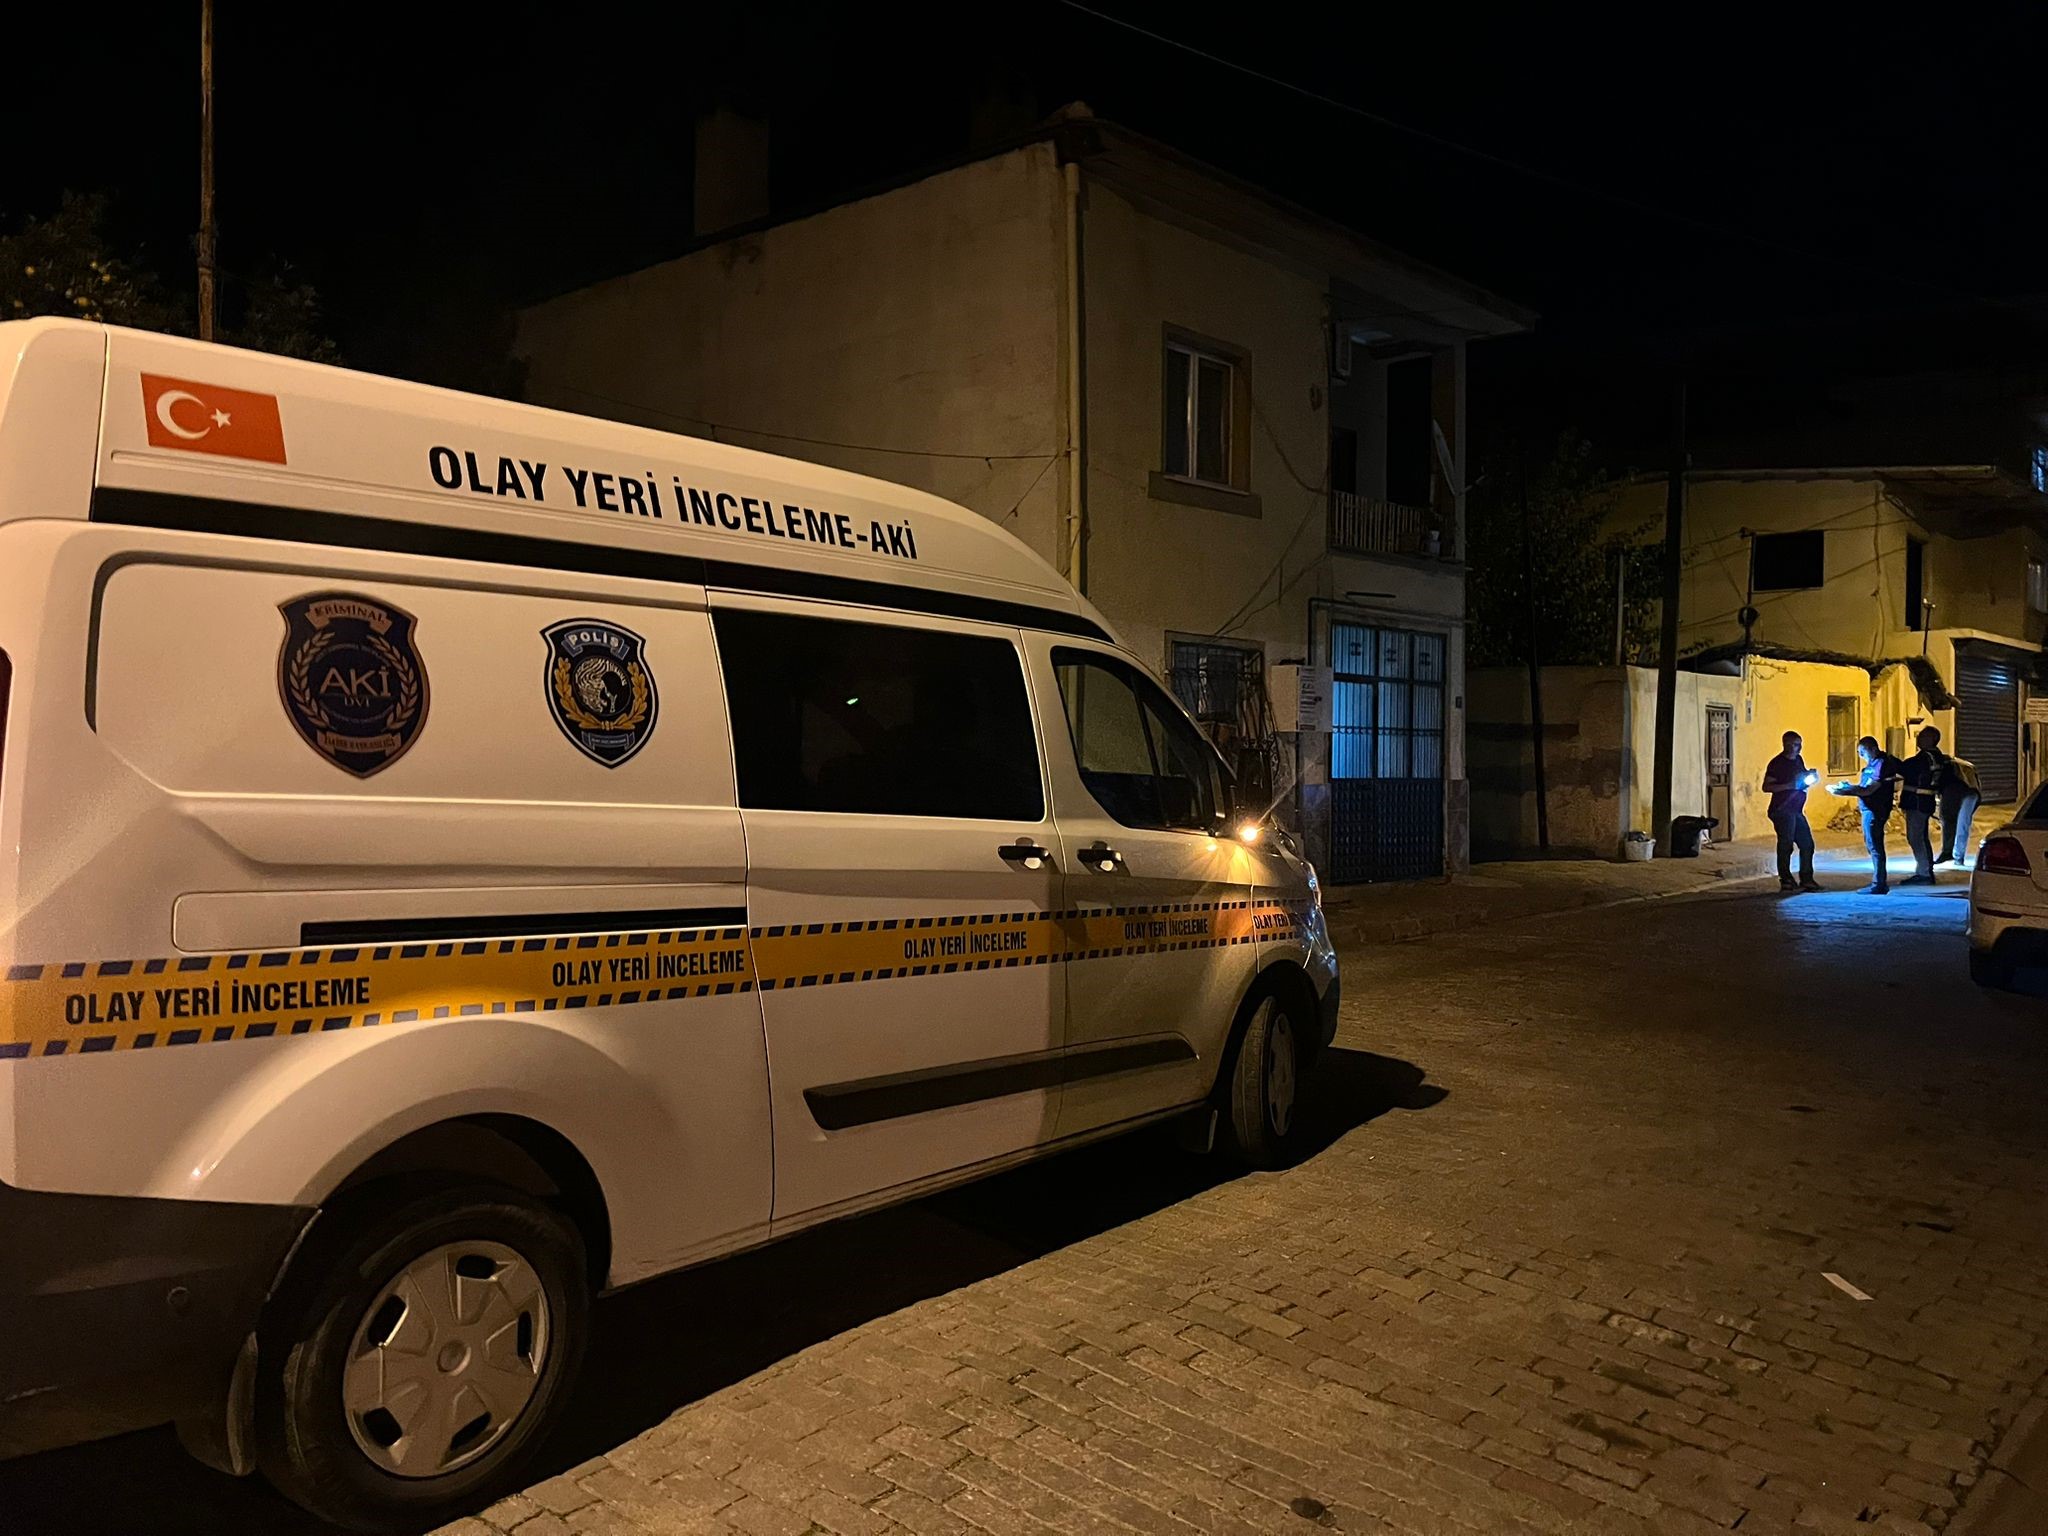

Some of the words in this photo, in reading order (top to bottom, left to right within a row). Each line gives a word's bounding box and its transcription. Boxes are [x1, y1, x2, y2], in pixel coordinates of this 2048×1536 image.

[428, 446, 548, 502] OLAY
[562, 466, 663, 518] YERİ
[673, 476, 918, 560] İNCELEME-AKİ
[567, 631, 621, 648] POLİS
[319, 665, 392, 699] AKİ
[1124, 922, 1147, 940] OLAY
[1169, 917, 1208, 937] İNCELEME
[1253, 914, 1273, 930] OLAY
[904, 937, 936, 960] OLAY
[939, 932, 966, 956] YERİ
[970, 931, 1027, 953] İNCELEME
[552, 960, 602, 987] OLAY
[608, 953, 650, 982] YERİ
[656, 949, 745, 979] İNCELEME
[65, 990, 144, 1026] OLAY
[154, 980, 220, 1018] YERİ
[231, 977, 371, 1014] İNCELEME
